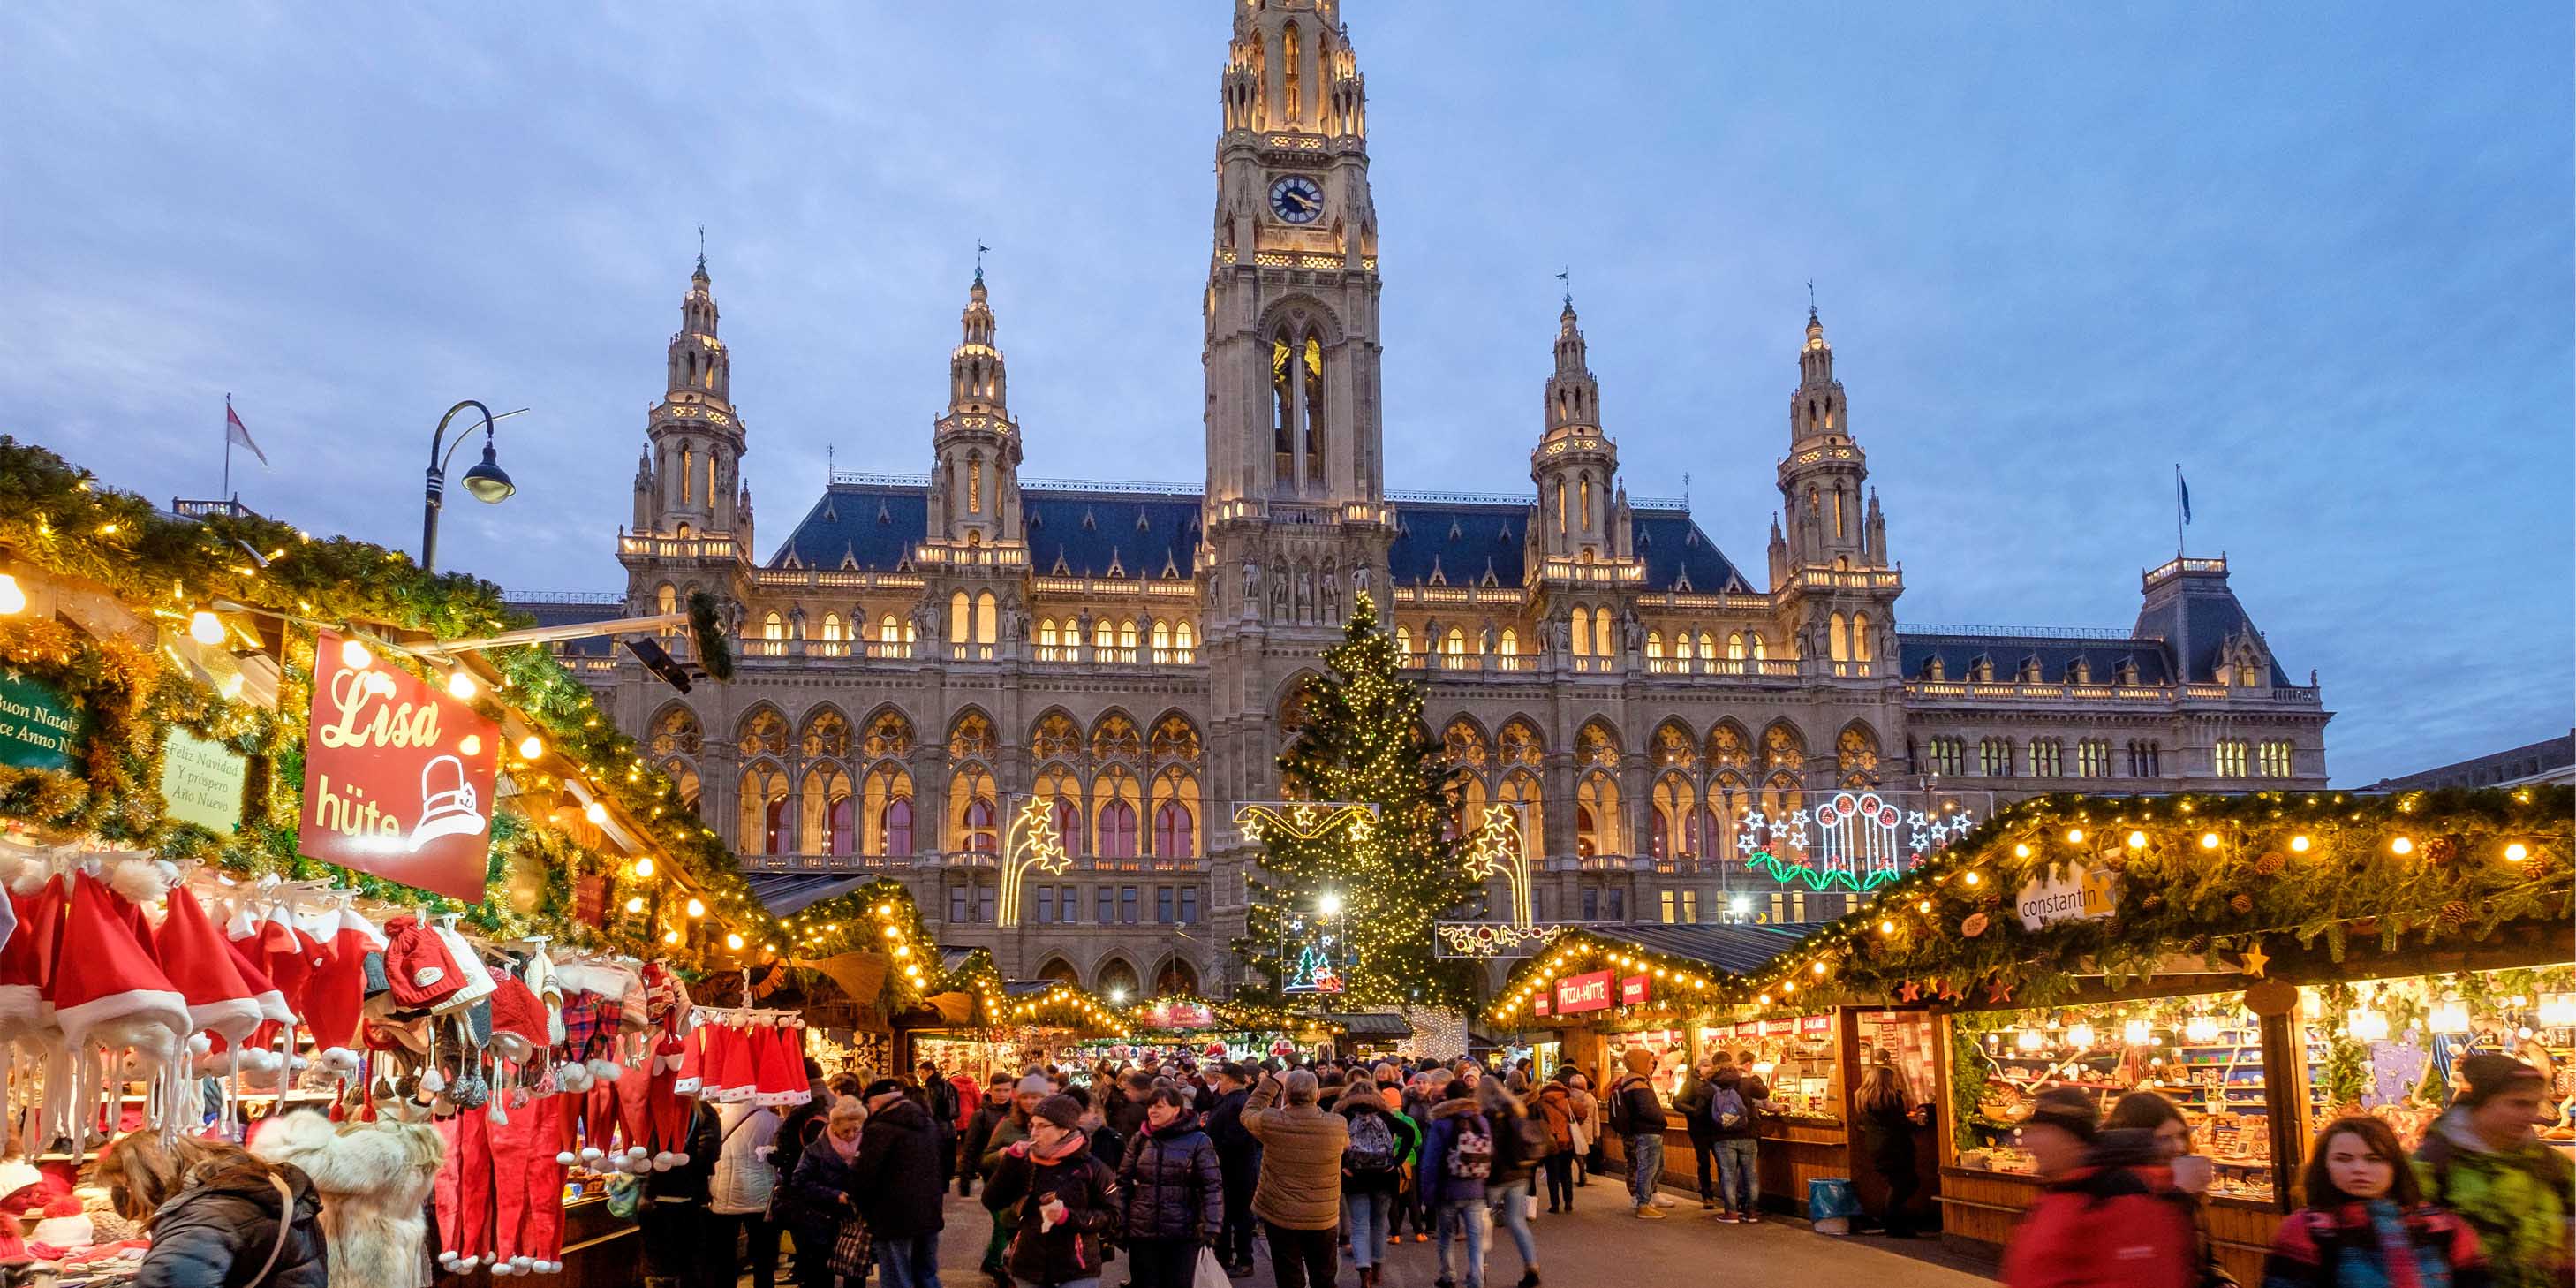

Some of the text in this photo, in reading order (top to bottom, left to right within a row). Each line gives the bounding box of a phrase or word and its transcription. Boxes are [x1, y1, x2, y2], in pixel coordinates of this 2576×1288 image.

[34, 706, 79, 733] Natale
[319, 668, 442, 749] Lisa
[16, 725, 56, 749] Anno
[168, 742, 238, 777] Feliz Navidad
[178, 764, 228, 793] Y próspero
[172, 785, 228, 813] Año Nuevo
[316, 774, 401, 839] hüte
[2022, 885, 2096, 917] constantin
